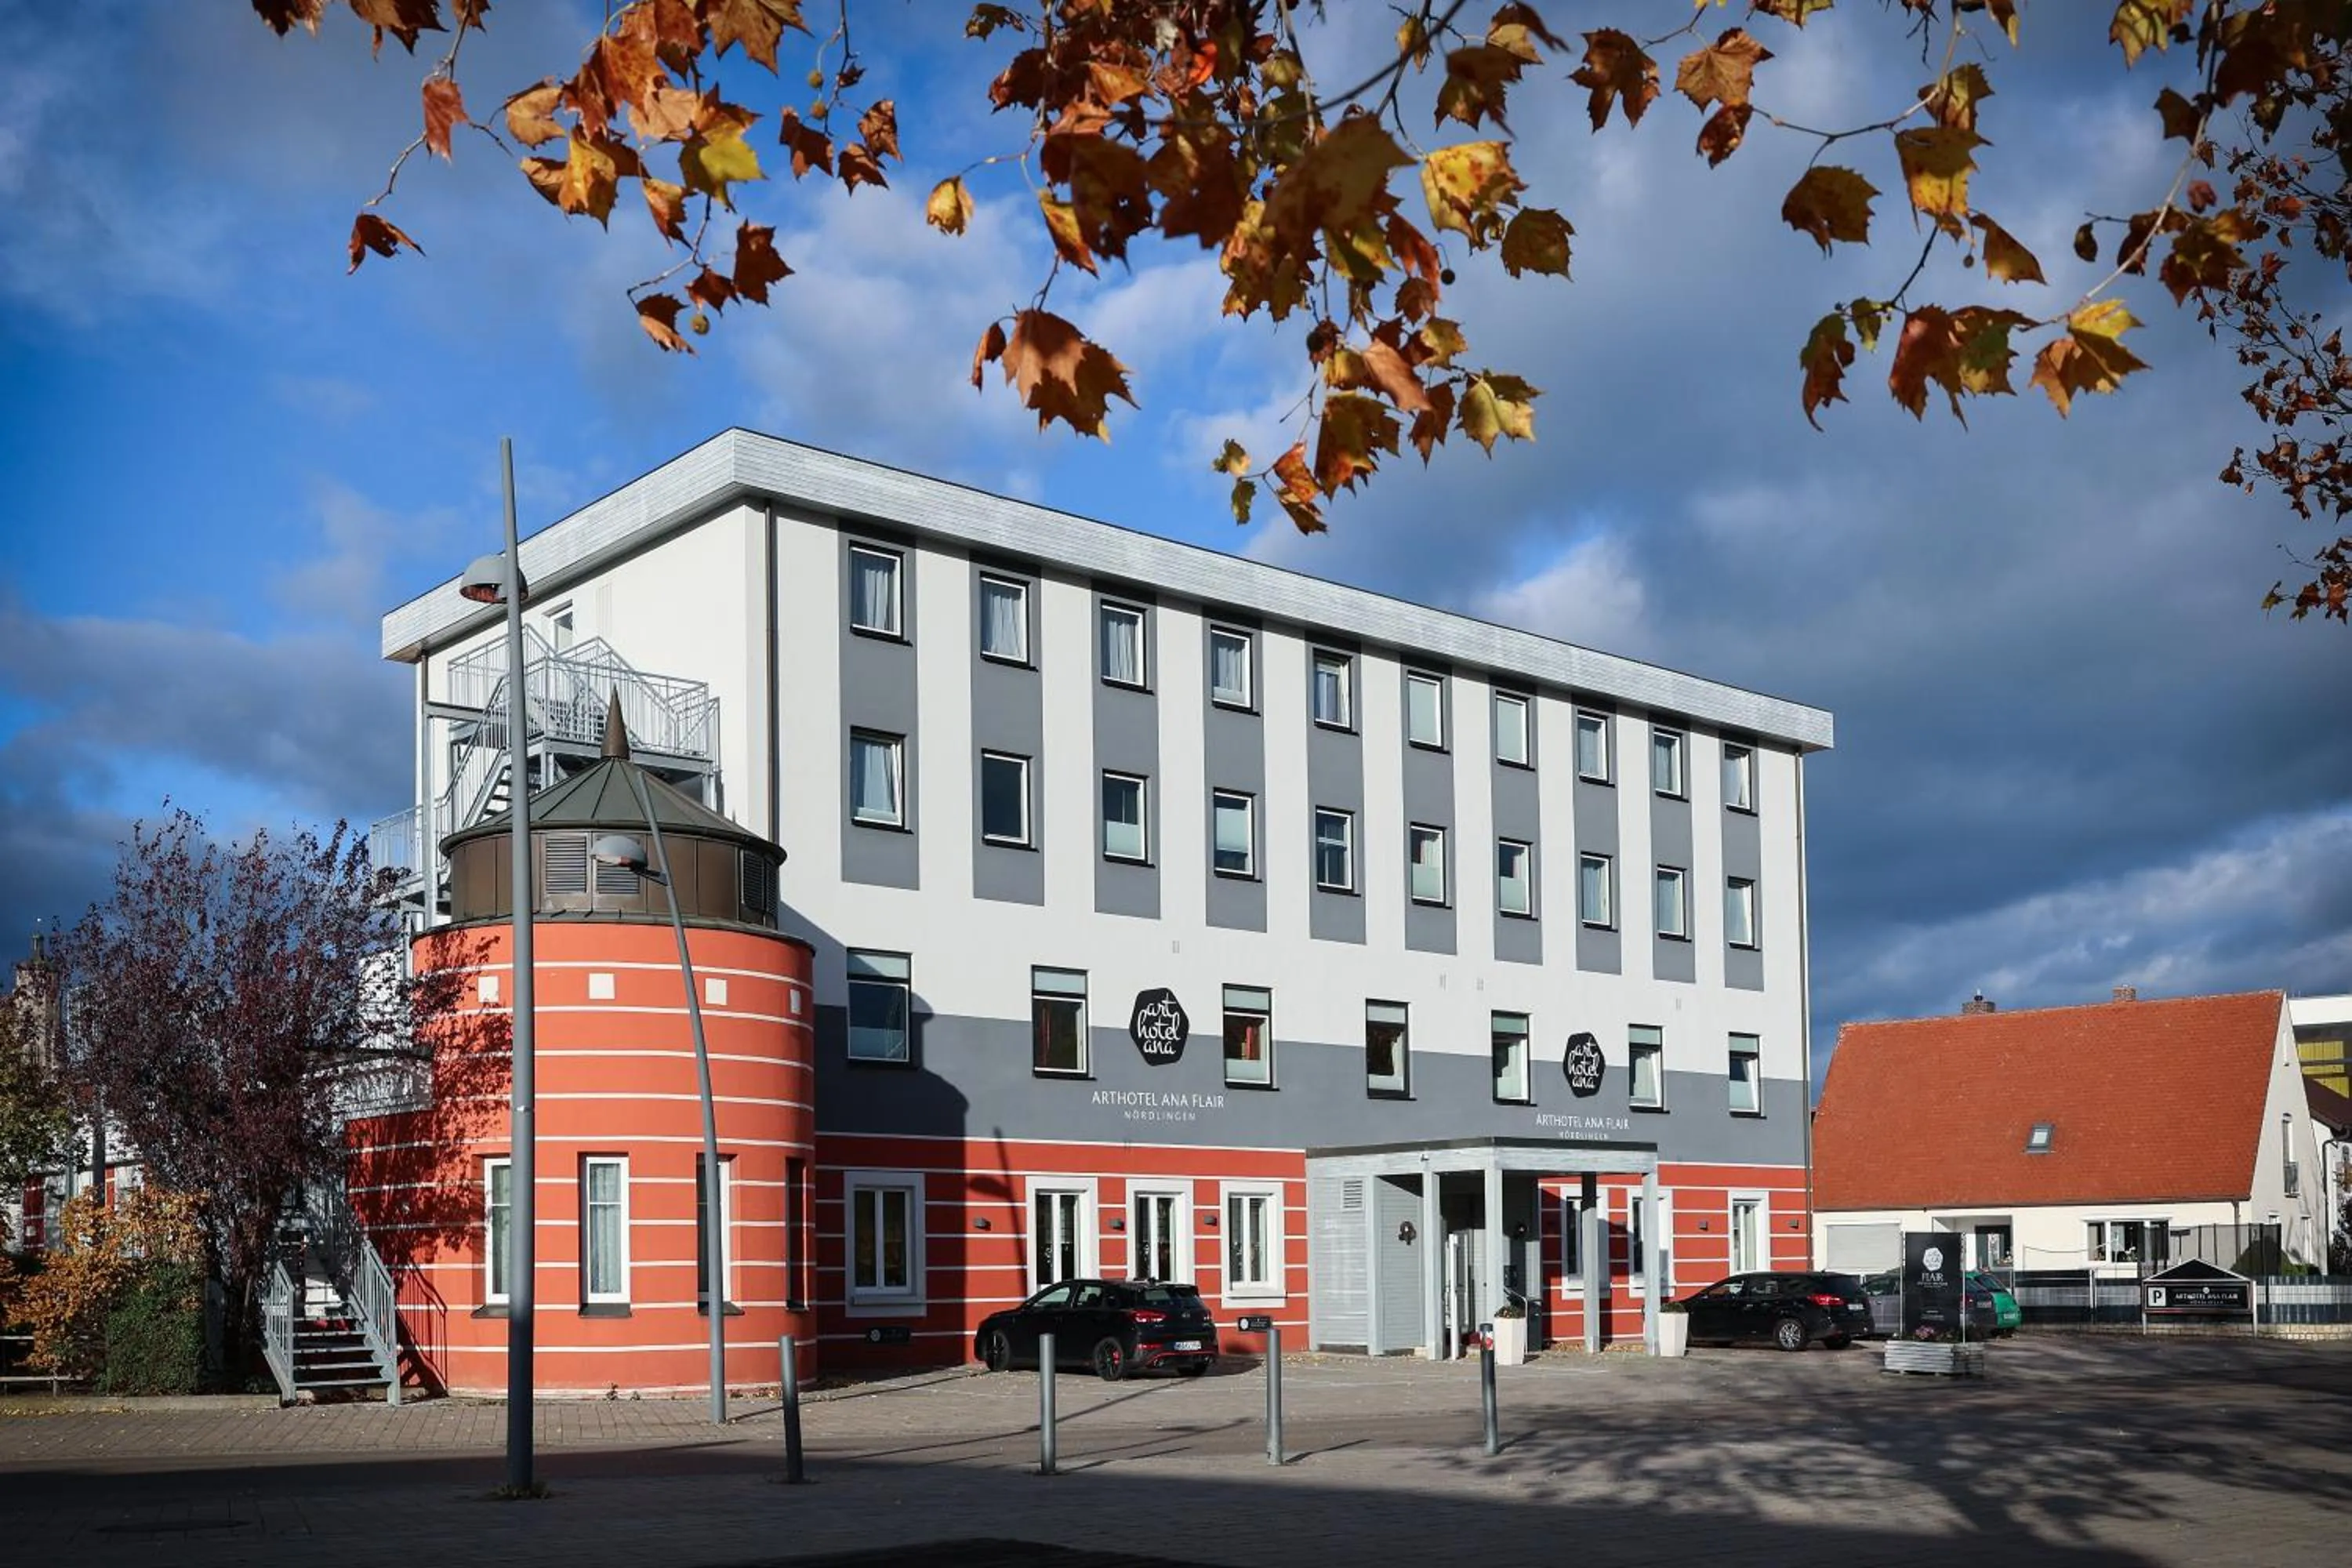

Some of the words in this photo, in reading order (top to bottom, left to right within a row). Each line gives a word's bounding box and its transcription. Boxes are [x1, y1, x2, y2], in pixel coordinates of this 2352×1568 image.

[1146, 992, 1176, 1018] art
[1138, 1010, 1181, 1041] hotel
[1143, 1040, 1176, 1054] ana
[1574, 1036, 1597, 1057] art
[1569, 1051, 1600, 1076] hotel
[1572, 1077, 1595, 1089] ana
[1091, 1091, 1158, 1106] ARTHOTEL
[1161, 1093, 1189, 1108] ANA
[1192, 1094, 1224, 1108] FLAIR
[1536, 1113, 1583, 1128] ARTHOTEL
[1584, 1117, 1604, 1129] ANA
[1606, 1117, 1630, 1130] FLAIR
[2153, 1290, 2161, 1303] P
